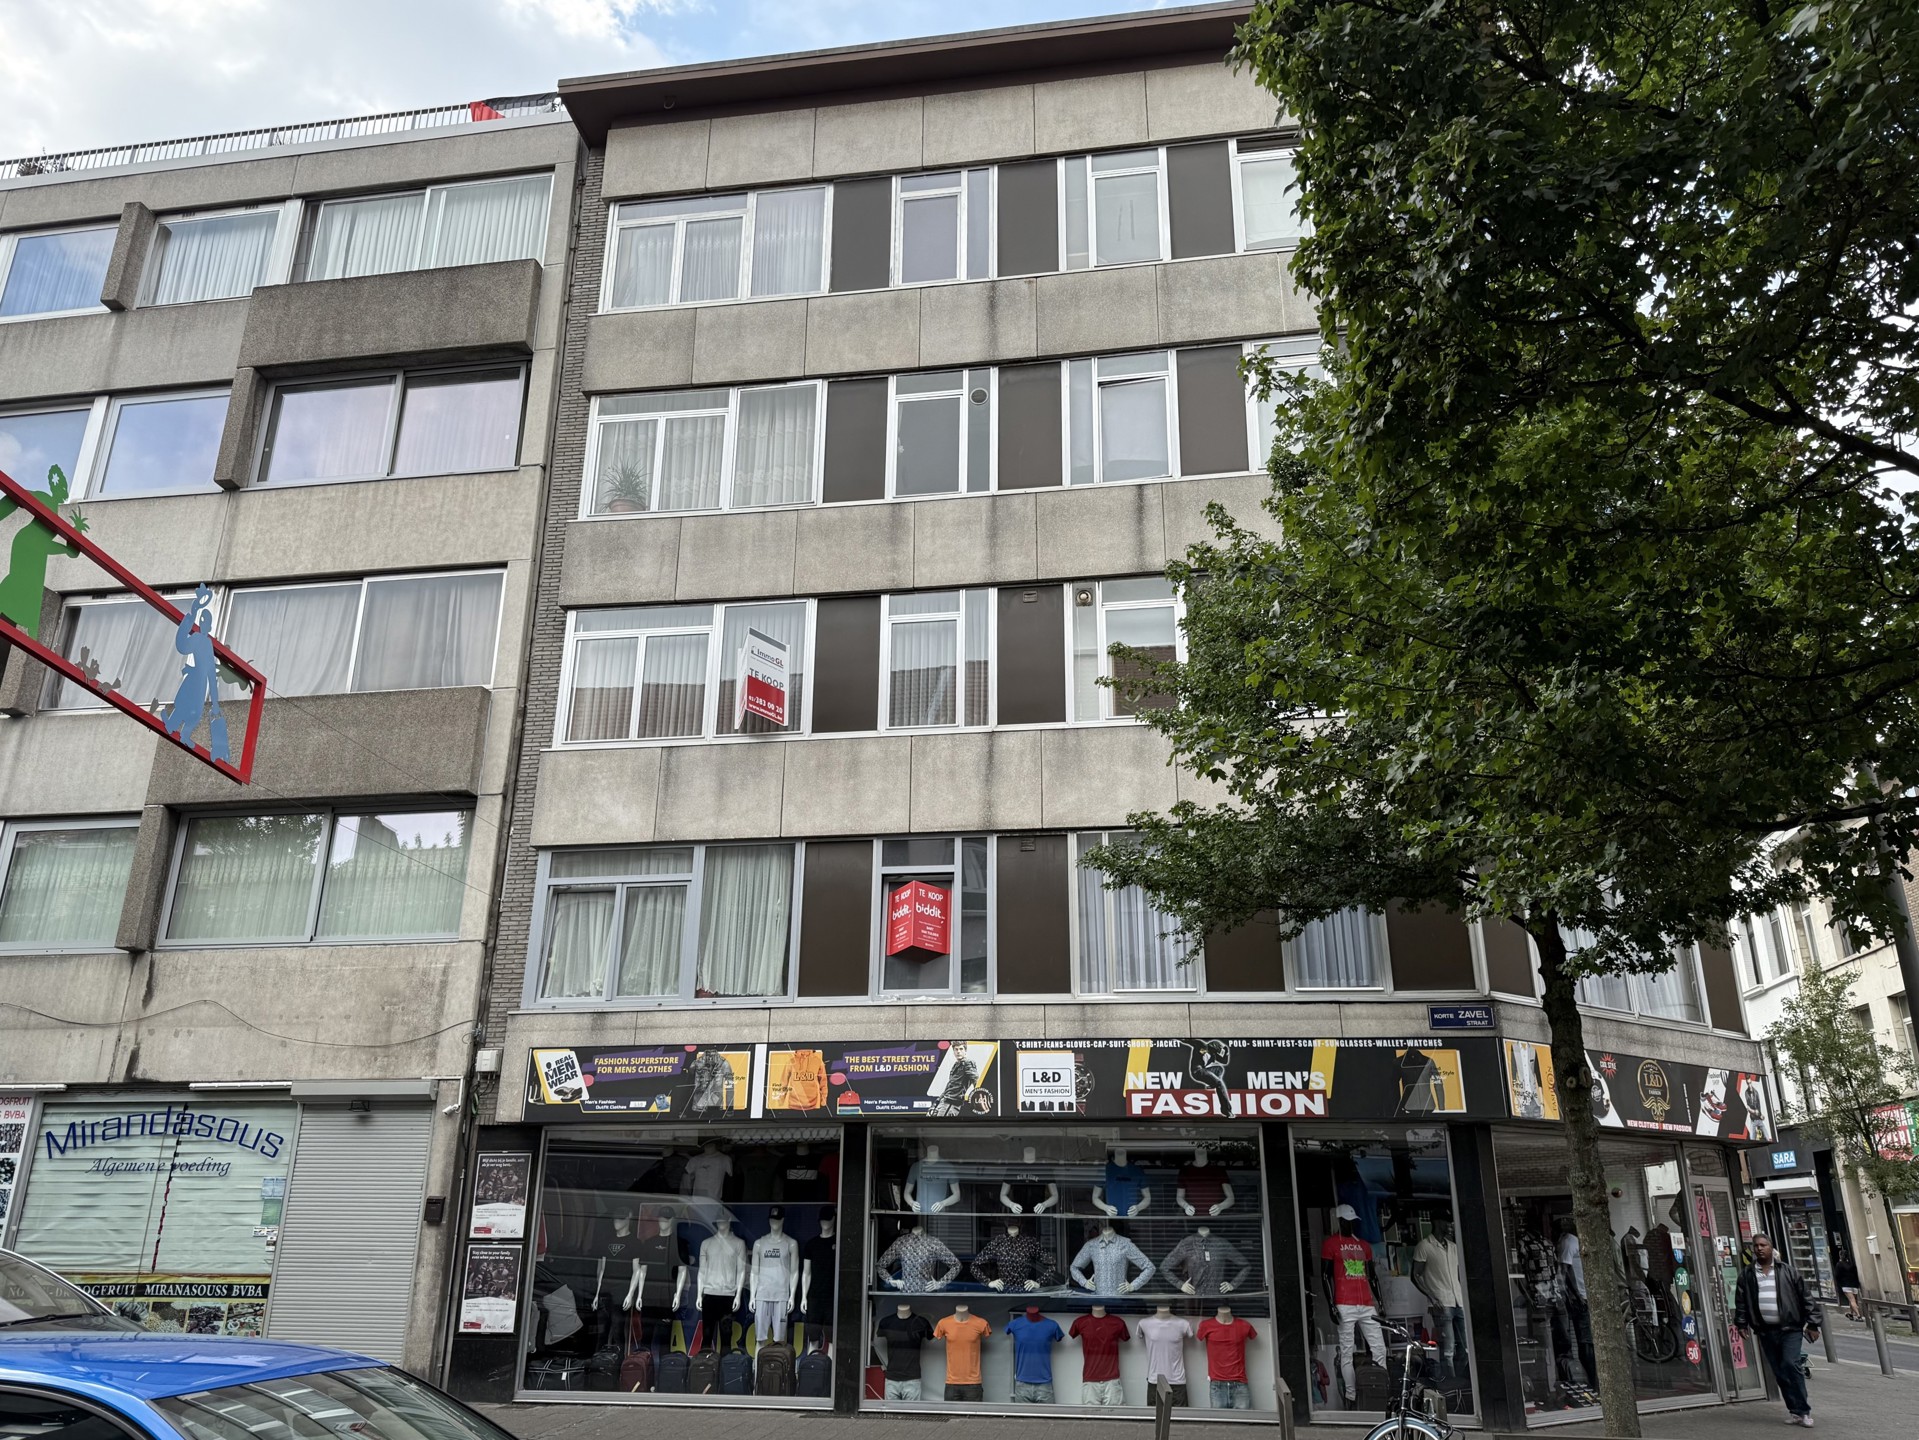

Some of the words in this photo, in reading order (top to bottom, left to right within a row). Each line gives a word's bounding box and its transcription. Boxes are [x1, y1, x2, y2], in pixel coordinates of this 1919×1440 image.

[749, 667, 760, 680] TE
[761, 673, 784, 690] KOOP
[919, 888, 926, 898] TE
[928, 891, 944, 902] KOOP
[1458, 1010, 1489, 1019] ZAVEL
[555, 1054, 574, 1067] REAL
[594, 1057, 630, 1066] FASHION
[630, 1056, 679, 1065] SUPERSTORE
[845, 1055, 860, 1063] THE
[861, 1055, 881, 1063] BEST
[882, 1055, 910, 1063] STREET
[911, 1055, 936, 1063] STYLE
[545, 1059, 576, 1082] MEN
[597, 1066, 614, 1074] FOR
[614, 1065, 637, 1074] MENS
[638, 1065, 673, 1074] CLOTHES
[850, 1064, 873, 1072] FROM
[874, 1064, 892, 1072] L&D
[893, 1064, 930, 1072] FASHION
[547, 1070, 579, 1089] WEAR
[793, 1071, 814, 1082] L&D
[1033, 1071, 1062, 1083] L&D
[1127, 1071, 1183, 1090] NEW
[1246, 1071, 1326, 1090] MEN'S
[1643, 1072, 1663, 1088] L&D
[1131, 1092, 1325, 1116] FASHION
[4, 1110, 26, 1120] BVBA
[45, 1104, 285, 1160] Mirandasous
[1626, 1119, 1638, 1128] NEW
[1638, 1120, 1659, 1130] CLOTHES
[1662, 1122, 1673, 1131] NEW
[1673, 1124, 1693, 1133] PASSION
[1773, 1151, 1796, 1165] SARA
[85, 1157, 166, 1178] Algemene
[170, 1156, 232, 1178] voeding
[144, 1283, 228, 1298] MIRANASOUSS
[231, 1284, 263, 1298] BVBA
